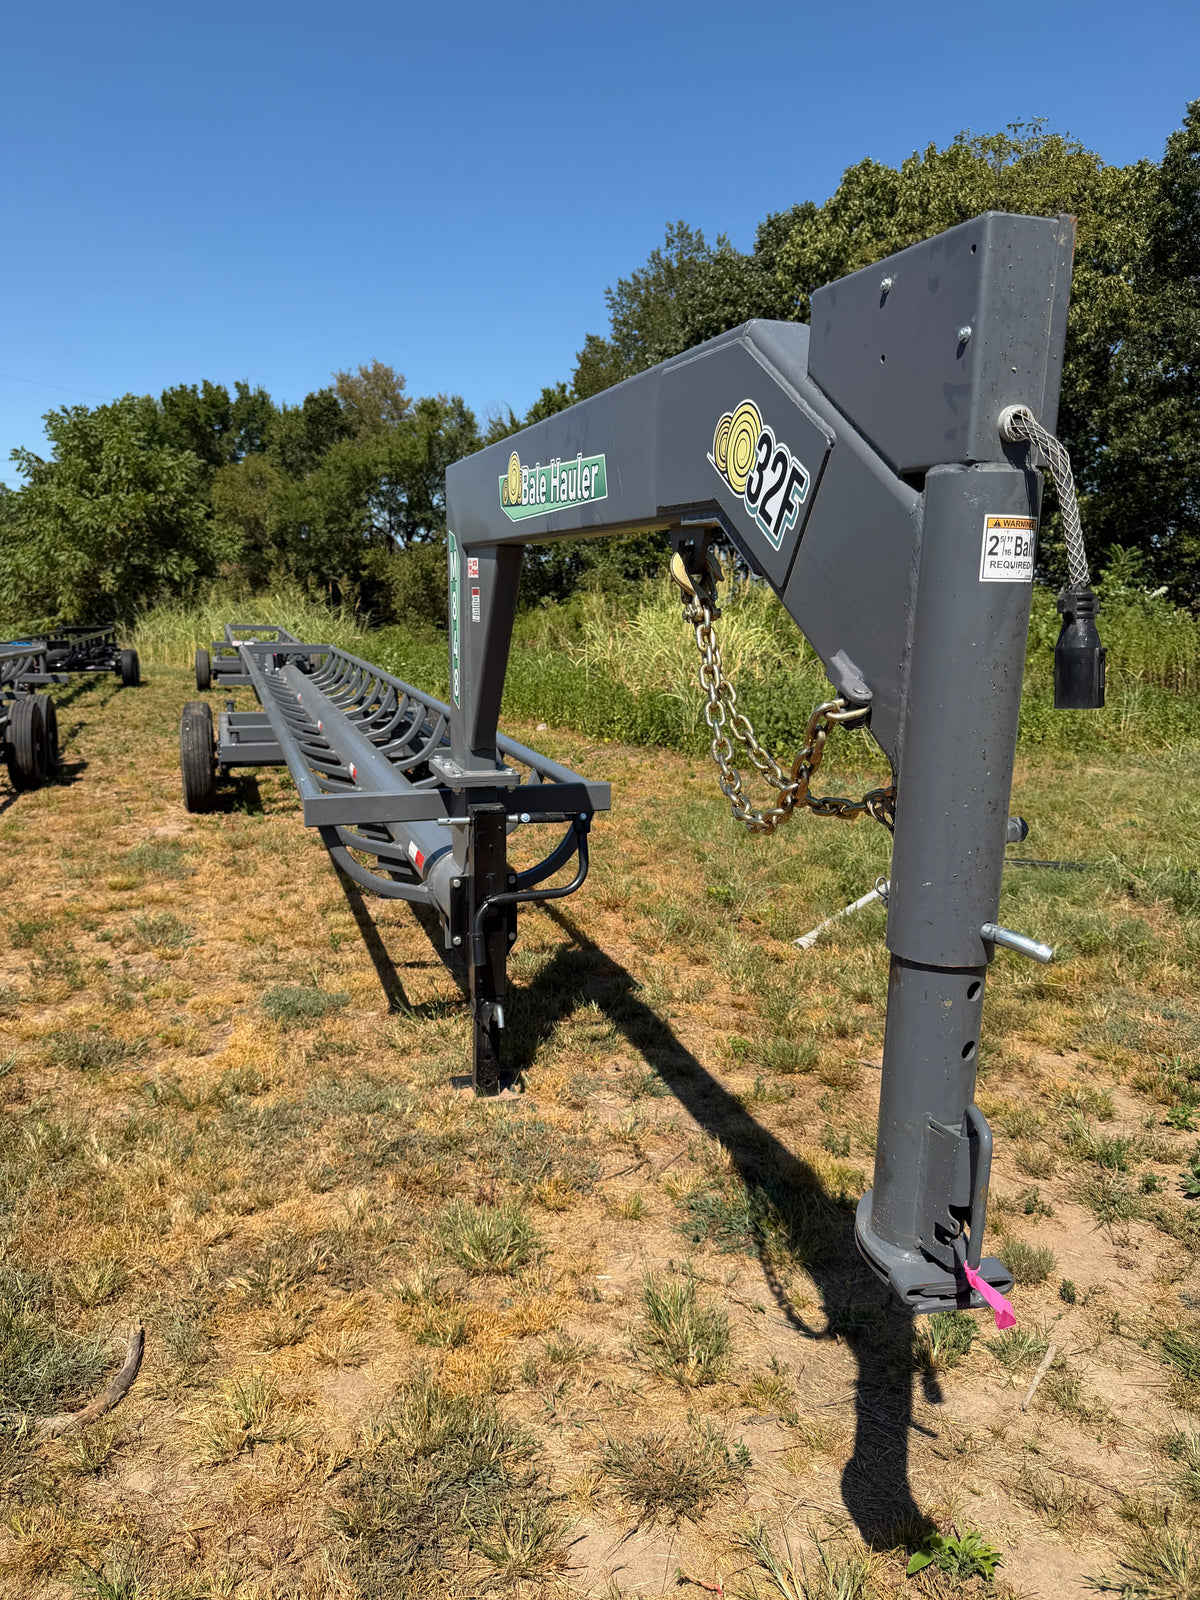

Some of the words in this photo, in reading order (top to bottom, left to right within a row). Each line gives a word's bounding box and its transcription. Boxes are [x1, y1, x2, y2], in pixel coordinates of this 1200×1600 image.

[521, 463, 547, 506] Bale
[550, 454, 600, 502] Hauler
[746, 432, 805, 537] 32F
[1003, 519, 1034, 529] WARNING
[989, 560, 1031, 570] REQUIRED
